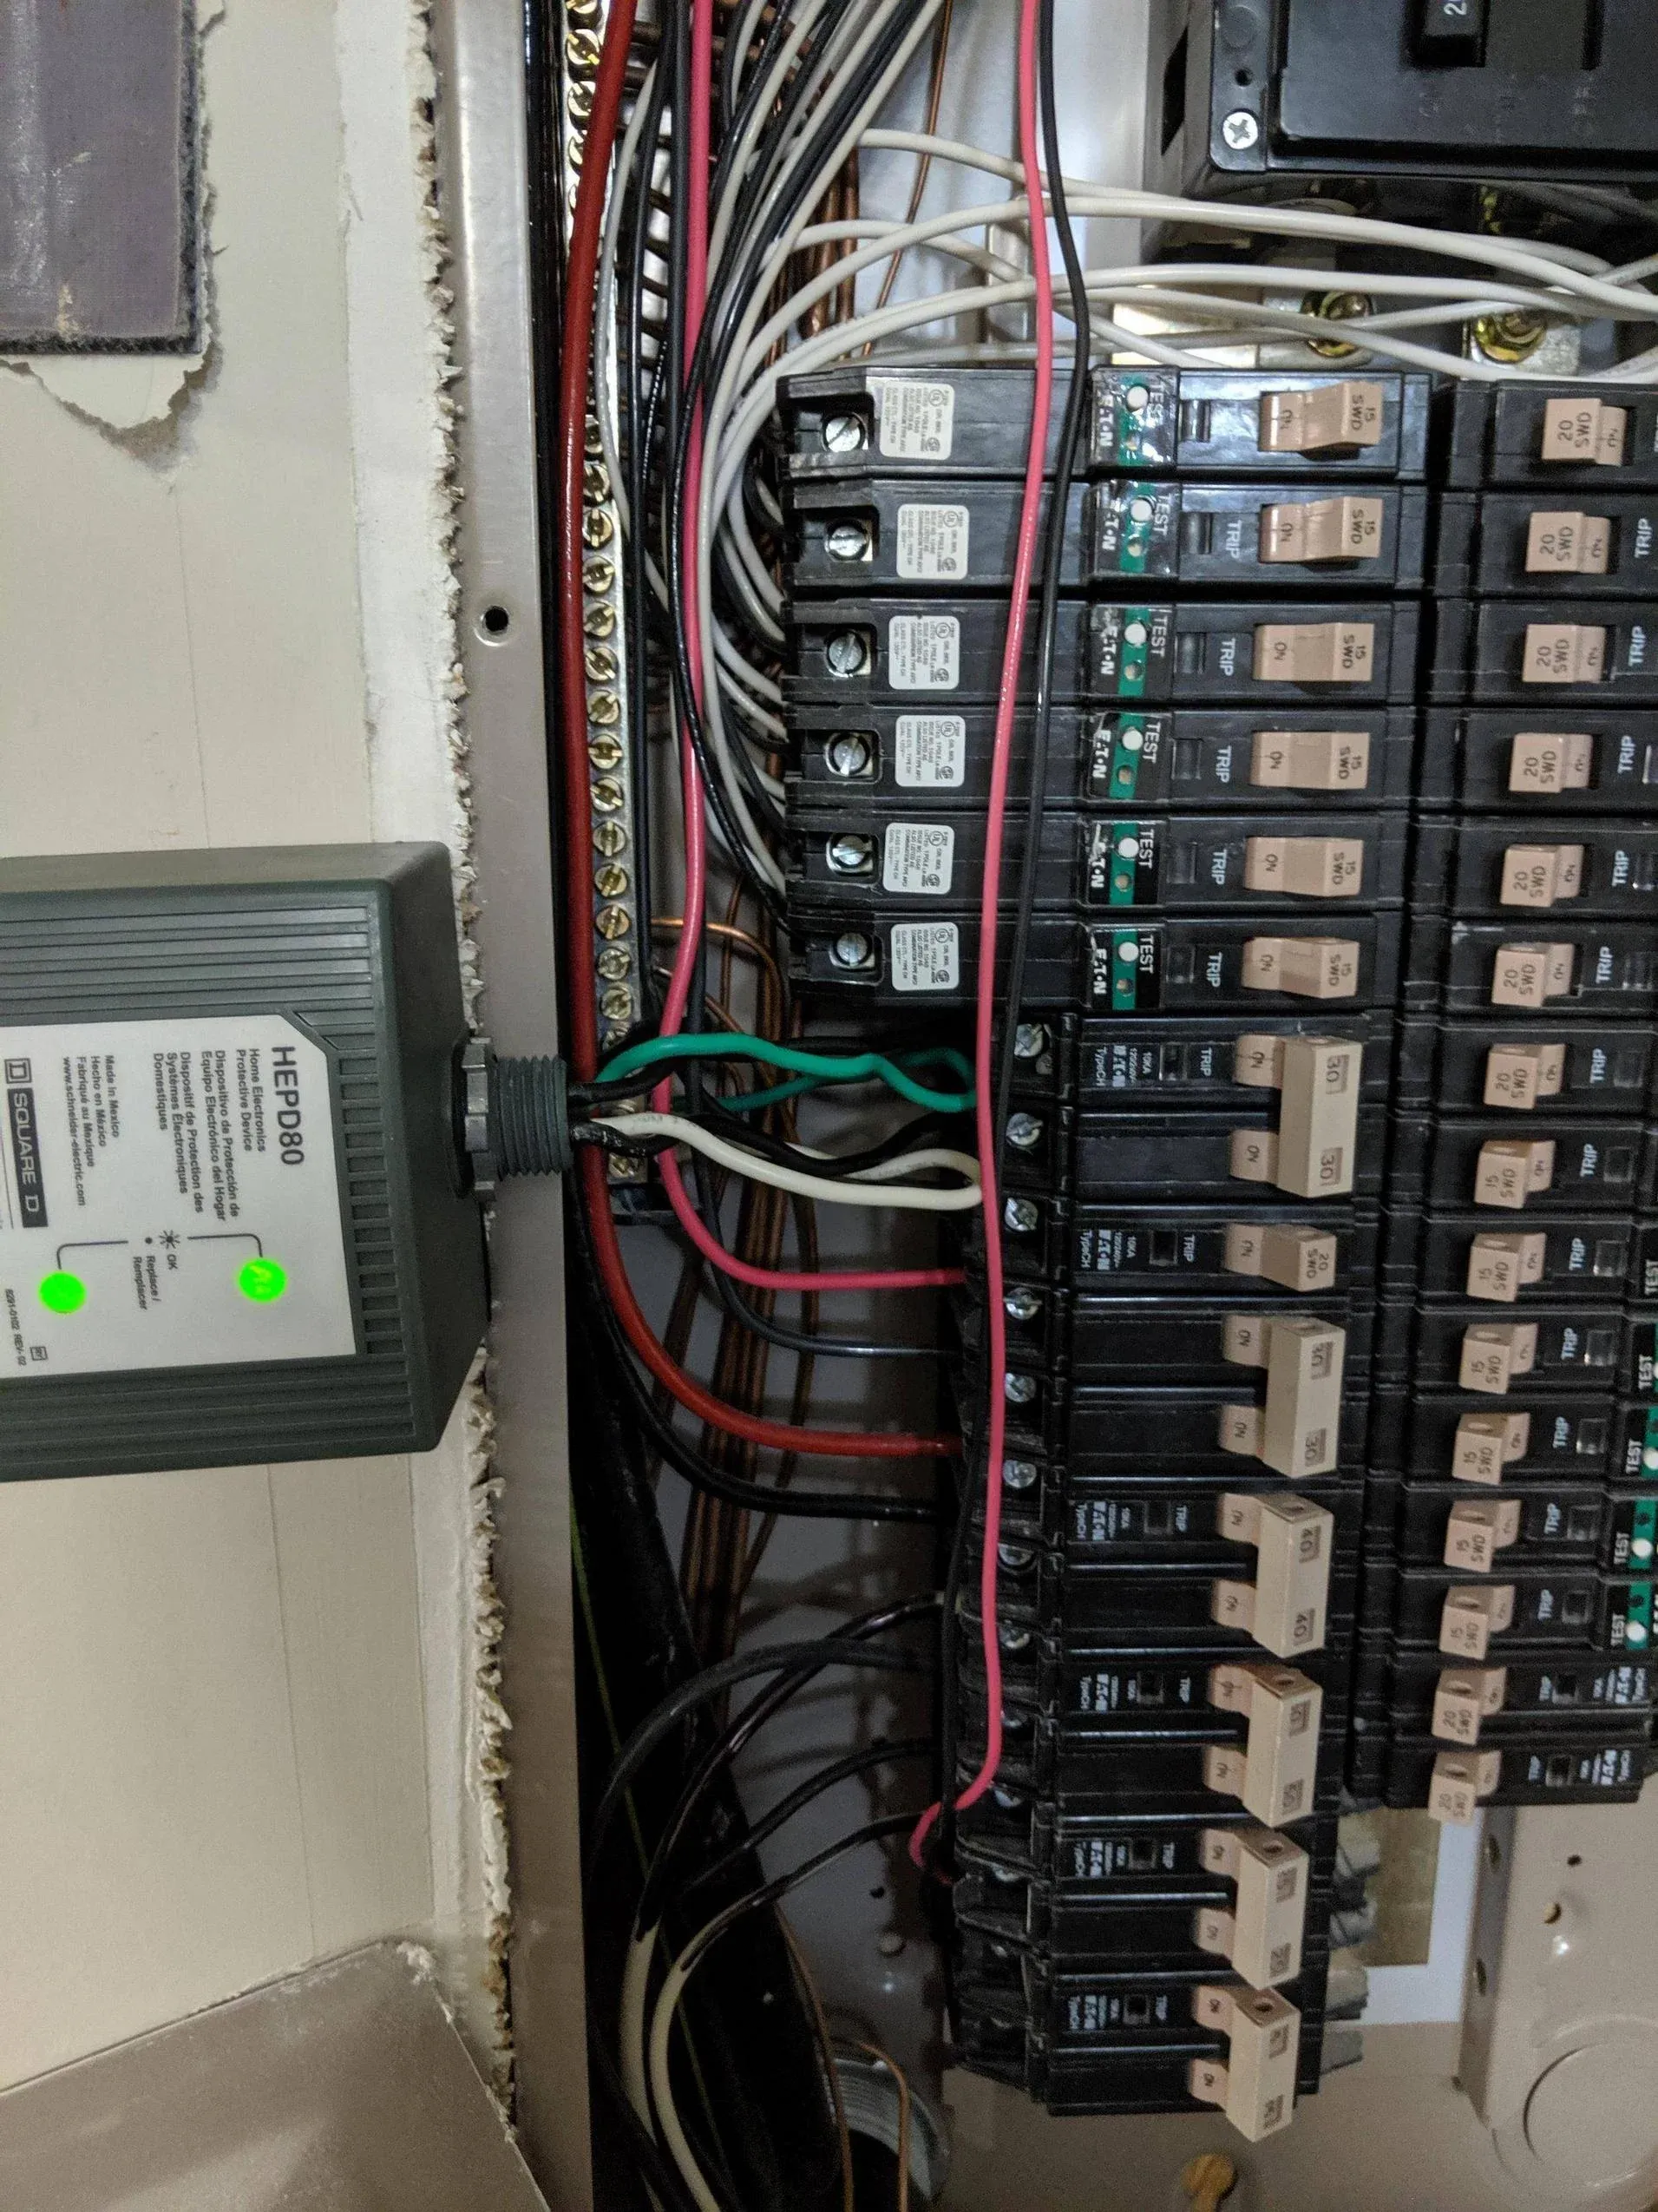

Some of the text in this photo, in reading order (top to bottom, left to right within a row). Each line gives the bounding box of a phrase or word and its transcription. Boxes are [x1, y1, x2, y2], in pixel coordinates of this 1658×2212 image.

[1149, 383, 1164, 426] TEST
[1281, 410, 1293, 429] ON
[1351, 394, 1364, 430] SWD
[1364, 407, 1376, 422] 15
[1557, 420, 1572, 441] 20
[1576, 412, 1592, 448] SWD
[1154, 495, 1171, 535] TEST
[1352, 509, 1364, 545] SWD
[1365, 521, 1376, 535] 15
[1225, 521, 1241, 559] TRIP
[1281, 523, 1293, 542] ON
[1539, 535, 1555, 555] 20
[1556, 526, 1572, 561] SWD
[1635, 518, 1652, 558] TRIP
[1151, 616, 1168, 656] TEST
[1342, 633, 1354, 668] SWD
[1628, 626, 1645, 666] TRIP
[1220, 638, 1235, 675] TRIP
[1274, 642, 1287, 661] ON
[1355, 646, 1366, 660] 15
[1536, 646, 1550, 666] 20
[1553, 639, 1569, 673] SWD
[1144, 722, 1161, 764] TEST
[1617, 736, 1635, 774] TRIP
[1216, 746, 1232, 783] TRIP
[1270, 752, 1283, 769] ON
[1338, 746, 1351, 779] SWD
[1352, 755, 1362, 769] 15
[1524, 758, 1537, 778] 20
[1541, 752, 1556, 784] SWD
[1138, 830, 1154, 868] TEST
[1265, 854, 1278, 871] ON
[1211, 850, 1227, 884] TRIP
[1333, 852, 1344, 885] SWD
[1346, 861, 1355, 875] 15
[1513, 871, 1527, 890] 20
[1530, 866, 1545, 897] SWD
[1612, 850, 1629, 887] TRIP
[1139, 935, 1154, 974] TEST
[1260, 955, 1274, 972] ON
[1341, 963, 1352, 975] 15
[1596, 946, 1612, 984] TRIP
[1206, 953, 1222, 988] TRIP
[1328, 955, 1340, 986] SWD
[1504, 969, 1517, 988] 20
[1519, 964, 1535, 994] SWD
[105, 1055, 115, 1083] Made
[1142, 1052, 1152, 1074] 10KA
[1201, 1048, 1211, 1076] TRIP
[1249, 1052, 1265, 1068] ON
[1326, 1057, 1340, 1083] 30
[1589, 1048, 1607, 1083] TRIP
[154, 1053, 168, 1130] Domestiques
[1496, 1073, 1510, 1090] 20
[1511, 1069, 1527, 1099] SWD
[76, 1057, 95, 1166] Fabriqué au Mexique
[91, 1056, 107, 1146] Hecho en México
[237, 1049, 252, 1151] Protective Device
[250, 1048, 265, 1152] Home Electronics
[272, 1047, 305, 1165] HEPD80
[63, 1057, 86, 1205] www.schneider-electric.com
[109, 1099, 120, 1137] Mexico
[166, 1053, 189, 1194] Systèmes Électroniques
[180, 1053, 205, 1212] Dispositif de Protection des
[200, 1052, 226, 1220] Equipo Electrónico del Hogar
[213, 1051, 239, 1217] Dispositivo de Protección de
[14, 1093, 39, 1212] SQUARE D
[1246, 1145, 1260, 1163] ON
[1320, 1154, 1334, 1180] 30
[1580, 1144, 1597, 1177] TRIP
[1485, 1176, 1497, 1187] 15
[1500, 1169, 1515, 1198] SWD
[167, 1254, 177, 1270] OK
[1126, 1236, 1136, 1258] 10KA
[1183, 1236, 1195, 1262] TRIP
[1241, 1240, 1253, 1257] ON
[1319, 1253, 1329, 1270] 20
[1569, 1237, 1584, 1270] TRIP
[146, 1256, 158, 1296] Replace
[1307, 1249, 1317, 1279] SWD
[1478, 1268, 1491, 1279] 15
[1493, 1262, 1508, 1290] SWD
[1645, 1260, 1658, 1295] TEST
[134, 1257, 147, 1310] Remplacer
[1238, 1329, 1251, 1347] ON
[1561, 1328, 1577, 1359] TRIP
[1311, 1347, 1324, 1366] 30
[1471, 1361, 1484, 1373] 15
[1485, 1356, 1500, 1383] SWD
[1638, 1355, 1652, 1388] TEST
[1235, 1421, 1247, 1439] ON
[1553, 1417, 1569, 1448] TRIP
[1305, 1437, 1319, 1458] 30
[1463, 1452, 1476, 1463] 15
[1478, 1447, 1492, 1474] SWD
[1626, 1439, 1642, 1474] TEST
[1175, 1506, 1187, 1531] TRIP
[1544, 1503, 1560, 1534] TRIP
[1300, 1530, 1312, 1553] 40
[1457, 1539, 1469, 1552] 15
[1471, 1534, 1485, 1562] SWD
[1614, 1533, 1629, 1564] TEST
[1537, 1590, 1553, 1619] TRIP
[1294, 1612, 1308, 1637] 40
[1451, 1628, 1462, 1638] 15
[1465, 1623, 1478, 1649] SWD
[1610, 1614, 1624, 1647] TEST
[1180, 1677, 1190, 1703] TRIP
[1163, 1843, 1174, 1867] TRIP
